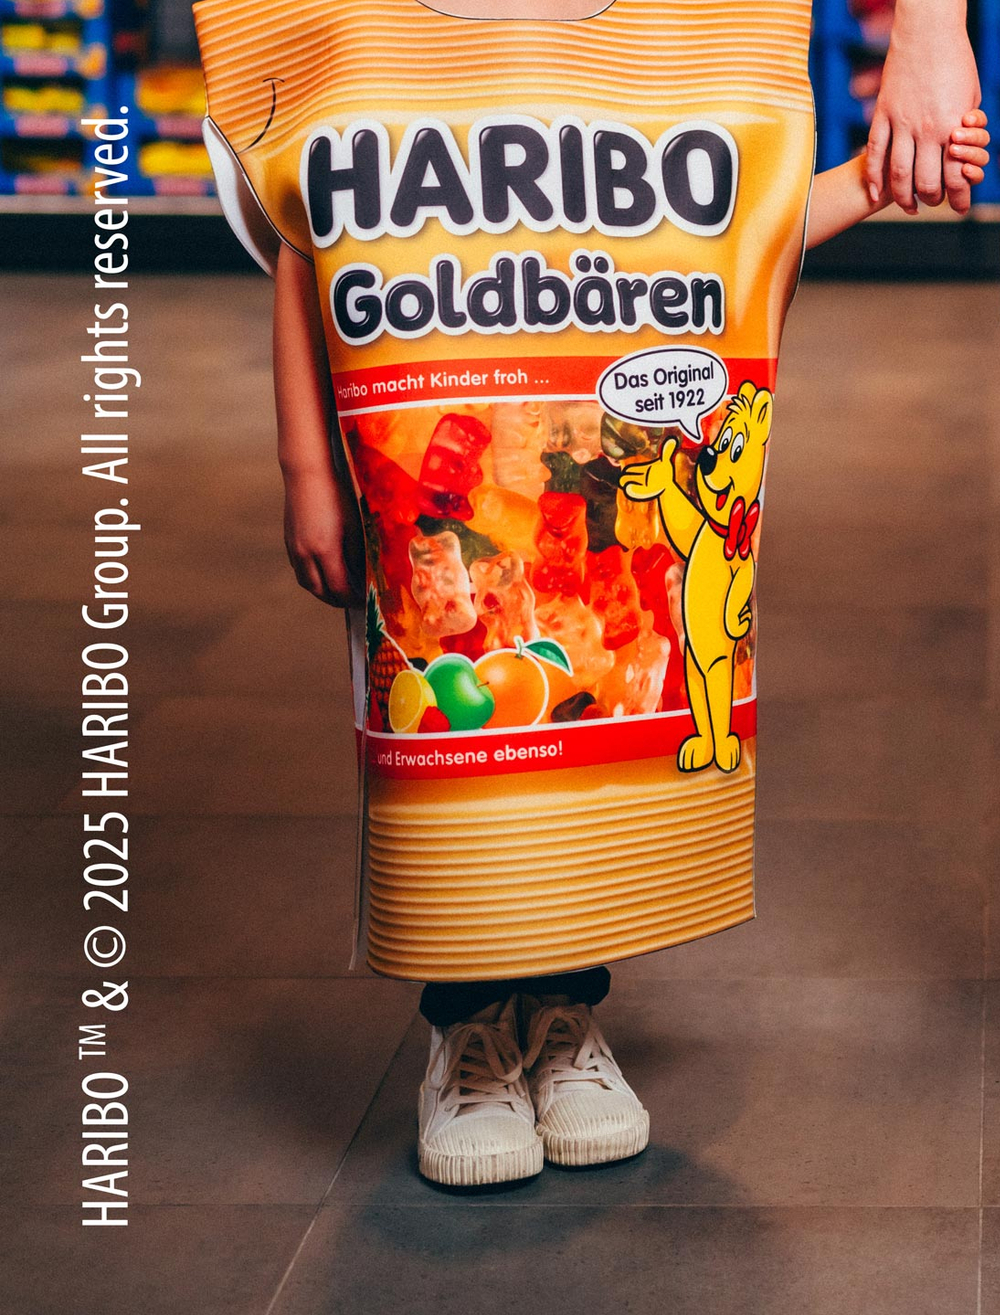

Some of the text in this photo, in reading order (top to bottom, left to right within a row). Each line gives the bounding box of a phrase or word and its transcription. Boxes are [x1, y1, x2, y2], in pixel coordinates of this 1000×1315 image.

[305, 122, 735, 239] HARIBO
[333, 254, 723, 339] Goldbären
[337, 382, 368, 400] Haribo
[372, 374, 425, 394] macht
[430, 370, 488, 388] Kinder
[493, 368, 528, 385] froh
[614, 361, 714, 390] Das Original
[635, 388, 705, 413] seit 1922
[377, 740, 563, 766] und Erwachsene ebenso!
